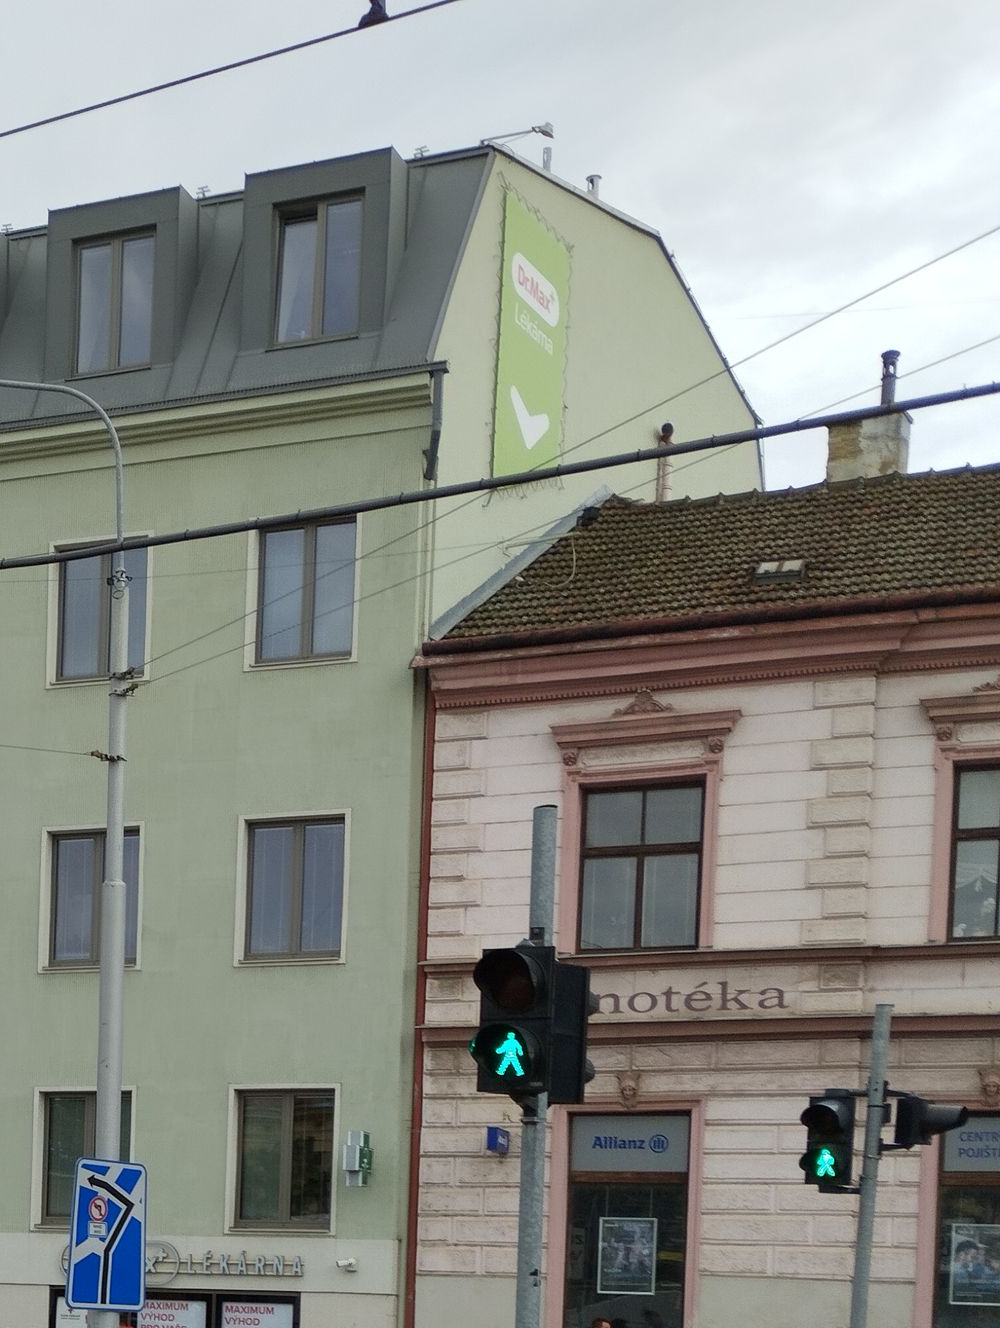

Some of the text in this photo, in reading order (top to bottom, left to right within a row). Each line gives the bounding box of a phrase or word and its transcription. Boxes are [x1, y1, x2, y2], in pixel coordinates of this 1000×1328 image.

[518, 263, 551, 314] Dr.Max
[960, 1131, 1000, 1142] CENTR
[592, 1136, 646, 1150] Allianz
[959, 1145, 1000, 1158] POJIŠT
[186, 1250, 304, 1277] LÉKÁRNA
[143, 1301, 189, 1311] MAXIMUM
[225, 1305, 275, 1315] MAXIMUM
[140, 1312, 175, 1322] VÝHOD
[224, 1316, 261, 1326] VÝHOD
